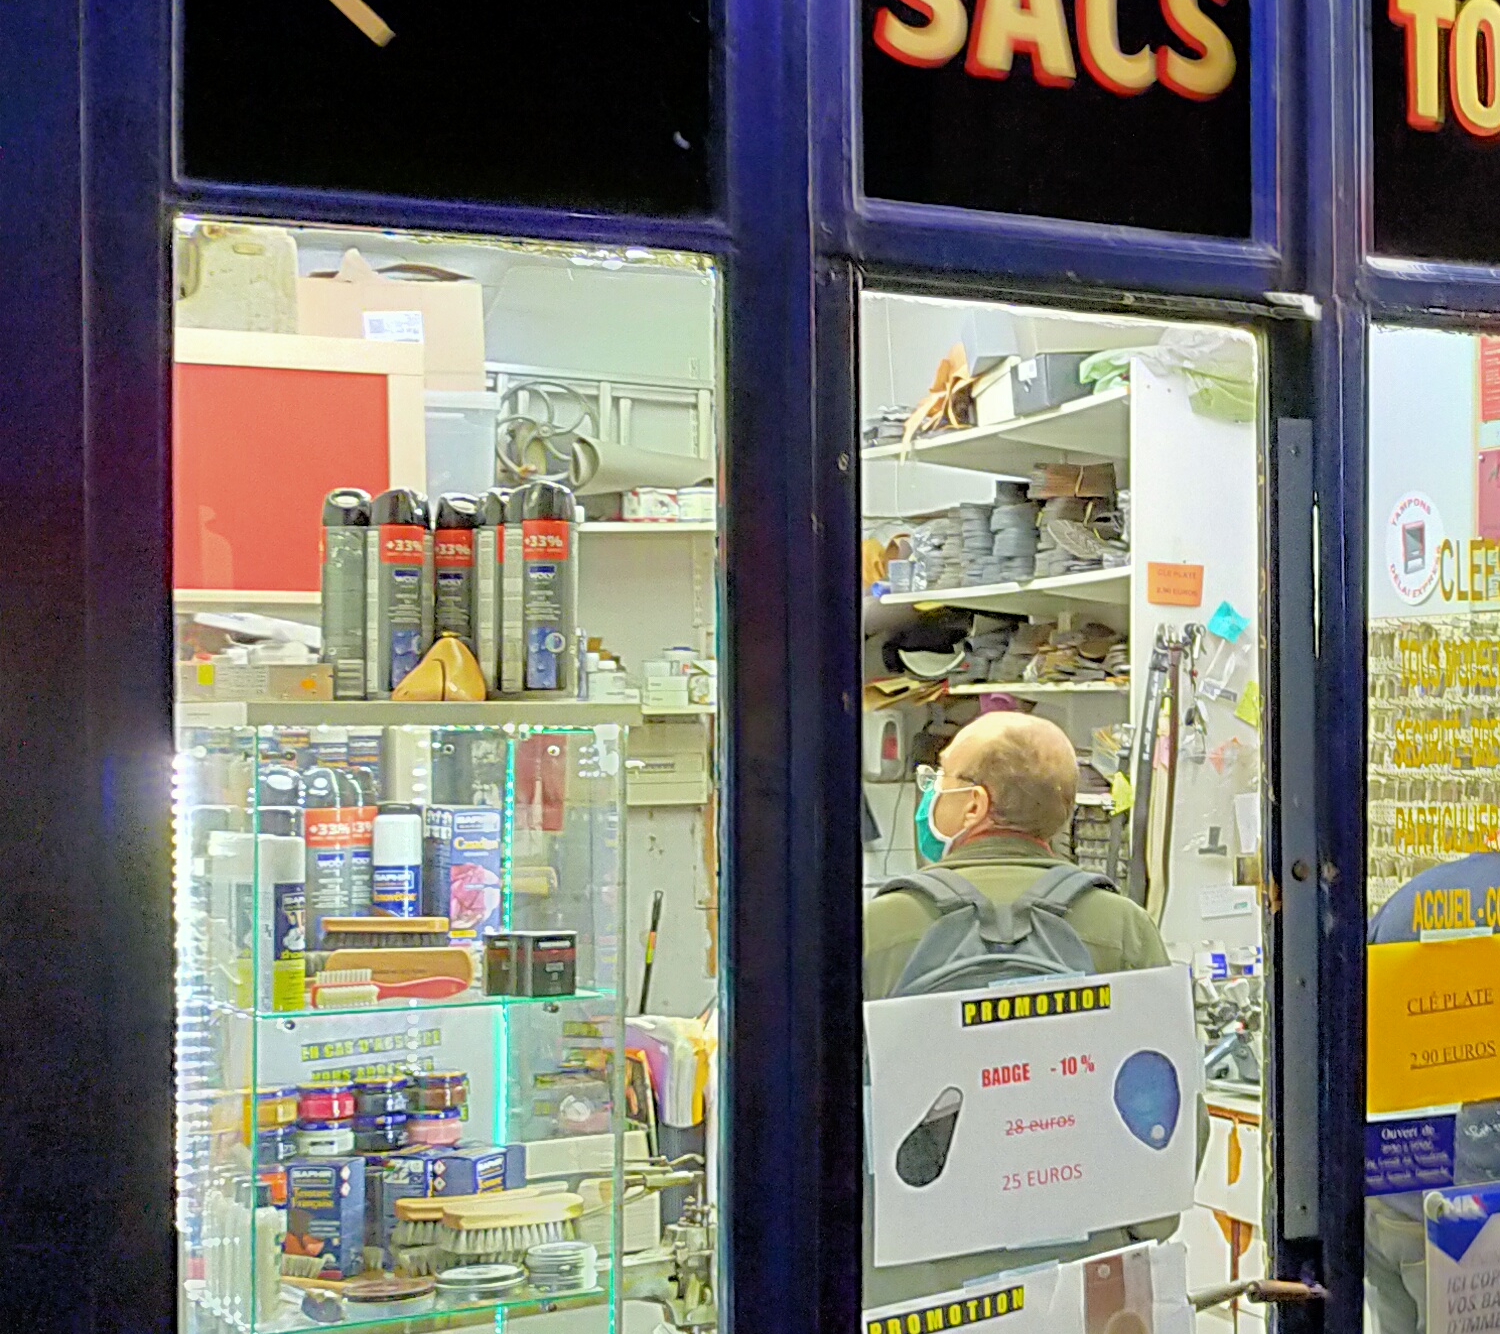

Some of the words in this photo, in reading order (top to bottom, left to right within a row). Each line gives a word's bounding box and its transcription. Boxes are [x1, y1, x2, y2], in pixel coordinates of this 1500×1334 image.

[1413, 889, 1475, 931] ACCUEIL
[964, 985, 1110, 1025] PROMOTION
[1443, 988, 1494, 1010] PLATE
[1443, 1040, 1497, 1064] EUROS
[981, 1063, 1030, 1088] BADGE
[1002, 1173, 1021, 1191] 25
[1027, 1164, 1083, 1187] EUROS
[1447, 1278, 1467, 1295] ICI
[1447, 1296, 1477, 1316] VOS
